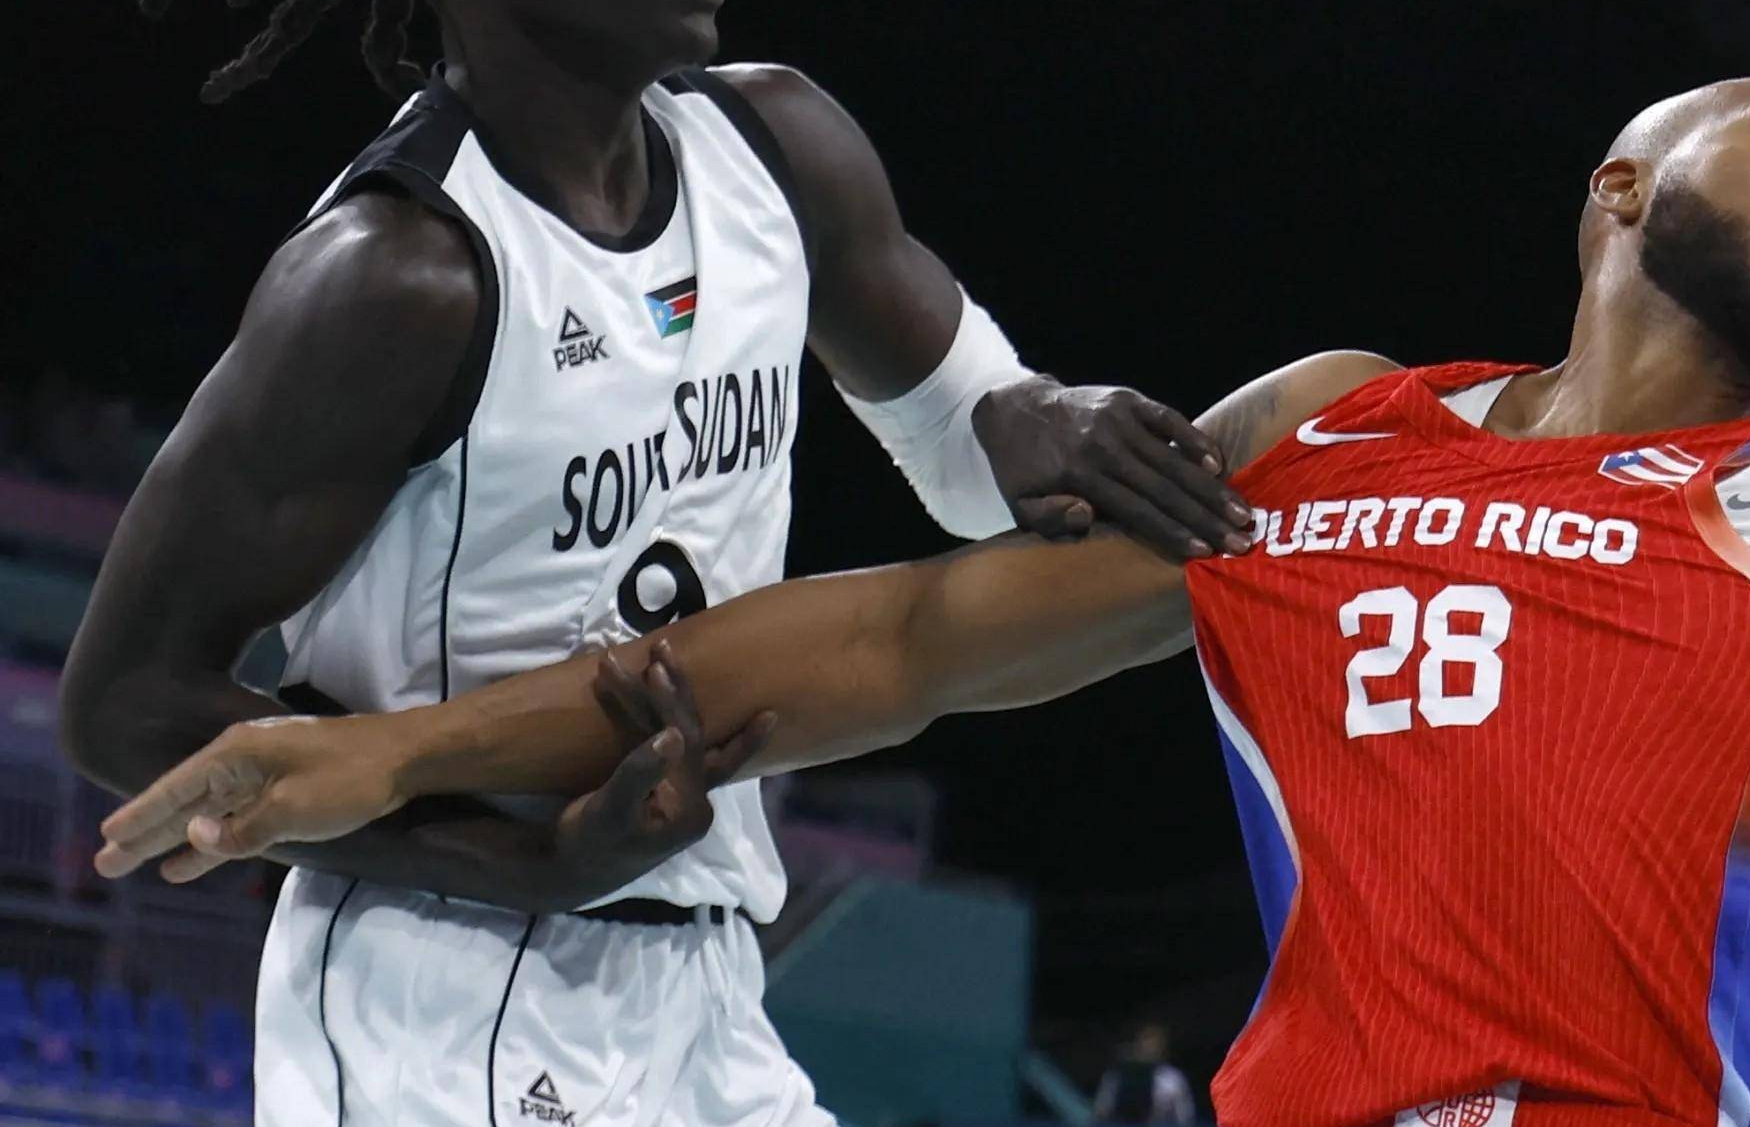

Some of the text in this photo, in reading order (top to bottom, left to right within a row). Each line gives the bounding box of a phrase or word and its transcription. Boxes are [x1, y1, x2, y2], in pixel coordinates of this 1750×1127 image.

[553, 335, 611, 372] PEAK
[673, 364, 789, 485] SUDAN
[1474, 501, 1639, 565] RICO
[1338, 584, 1512, 740] 28
[519, 1097, 576, 1127] PEAK
